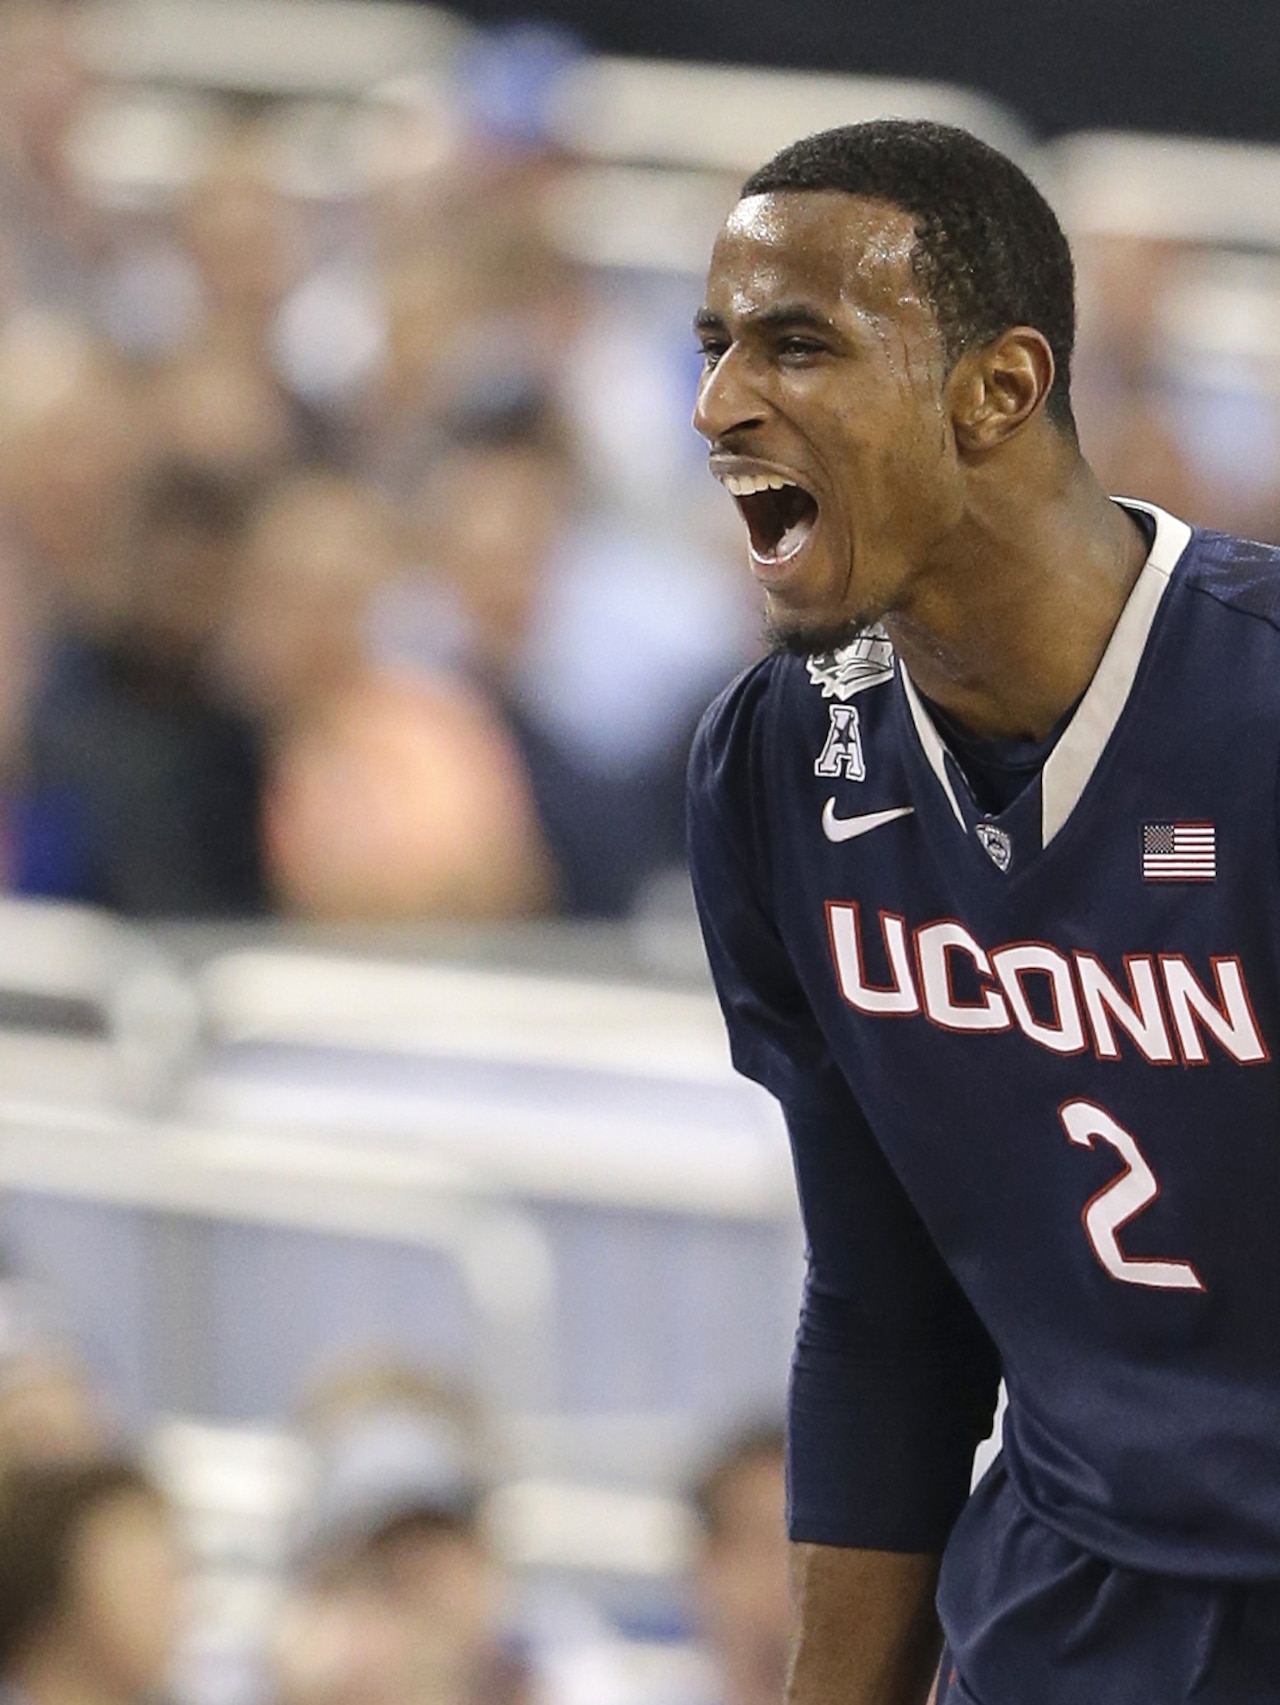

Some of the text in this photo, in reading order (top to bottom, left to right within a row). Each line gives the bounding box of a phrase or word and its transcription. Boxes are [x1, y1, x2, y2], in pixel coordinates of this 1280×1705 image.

[815, 705, 866, 781] A
[826, 901, 1270, 1064] UCONN
[1059, 1099, 1206, 1291] 2
